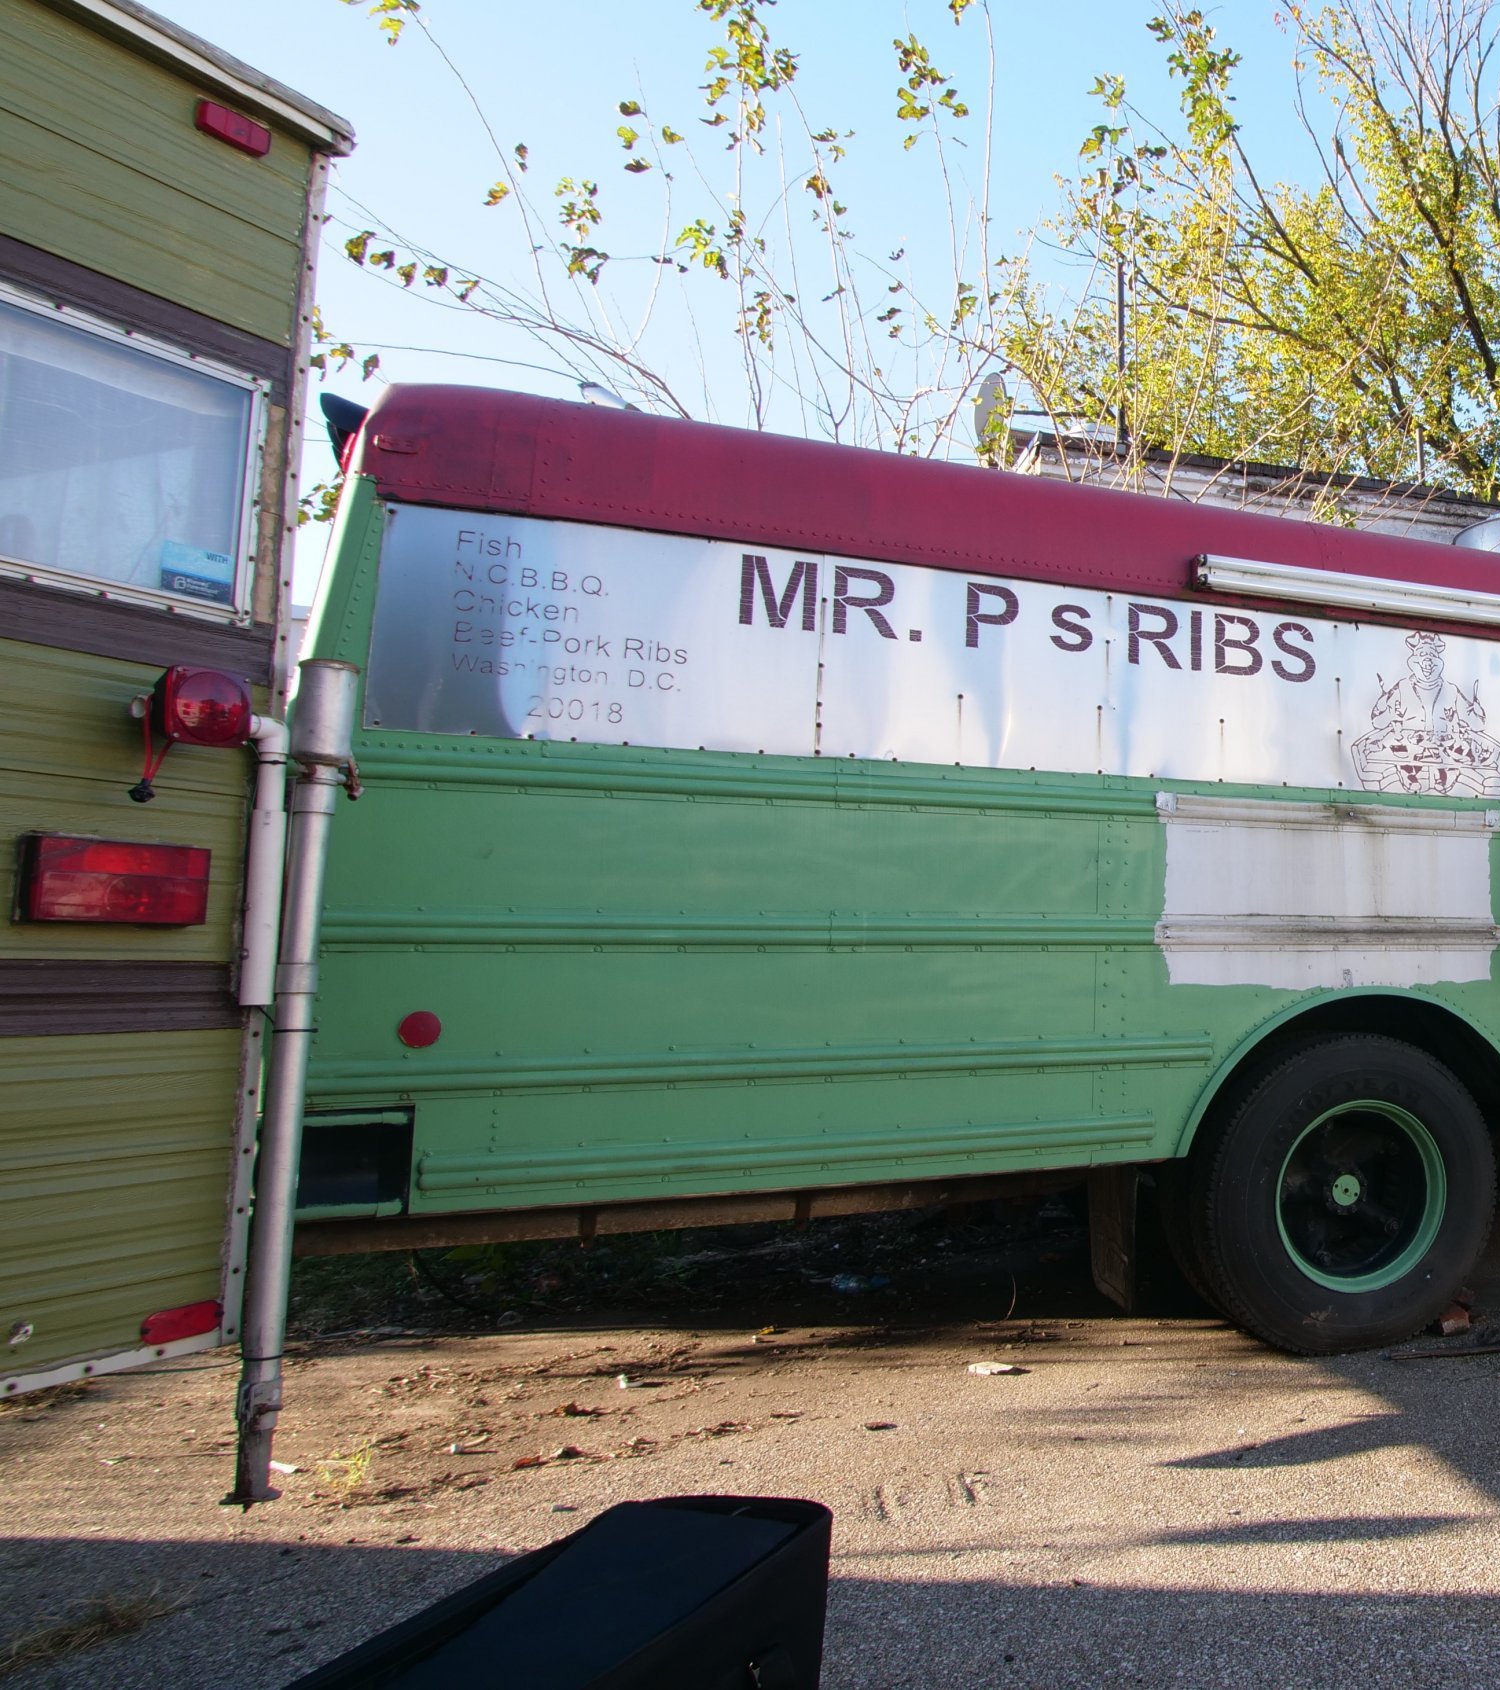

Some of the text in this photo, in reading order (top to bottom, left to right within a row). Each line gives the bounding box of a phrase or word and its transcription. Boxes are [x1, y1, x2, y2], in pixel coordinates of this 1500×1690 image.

[457, 530, 522, 559] Fish
[454, 589, 578, 623] Chicken
[739, 554, 922, 642] MR.
[1127, 602, 1316, 683] RIBS
[623, 637, 688, 665] Ribs
[452, 653, 681, 692] Wasngton D.C.
[527, 695, 623, 724] 20018
